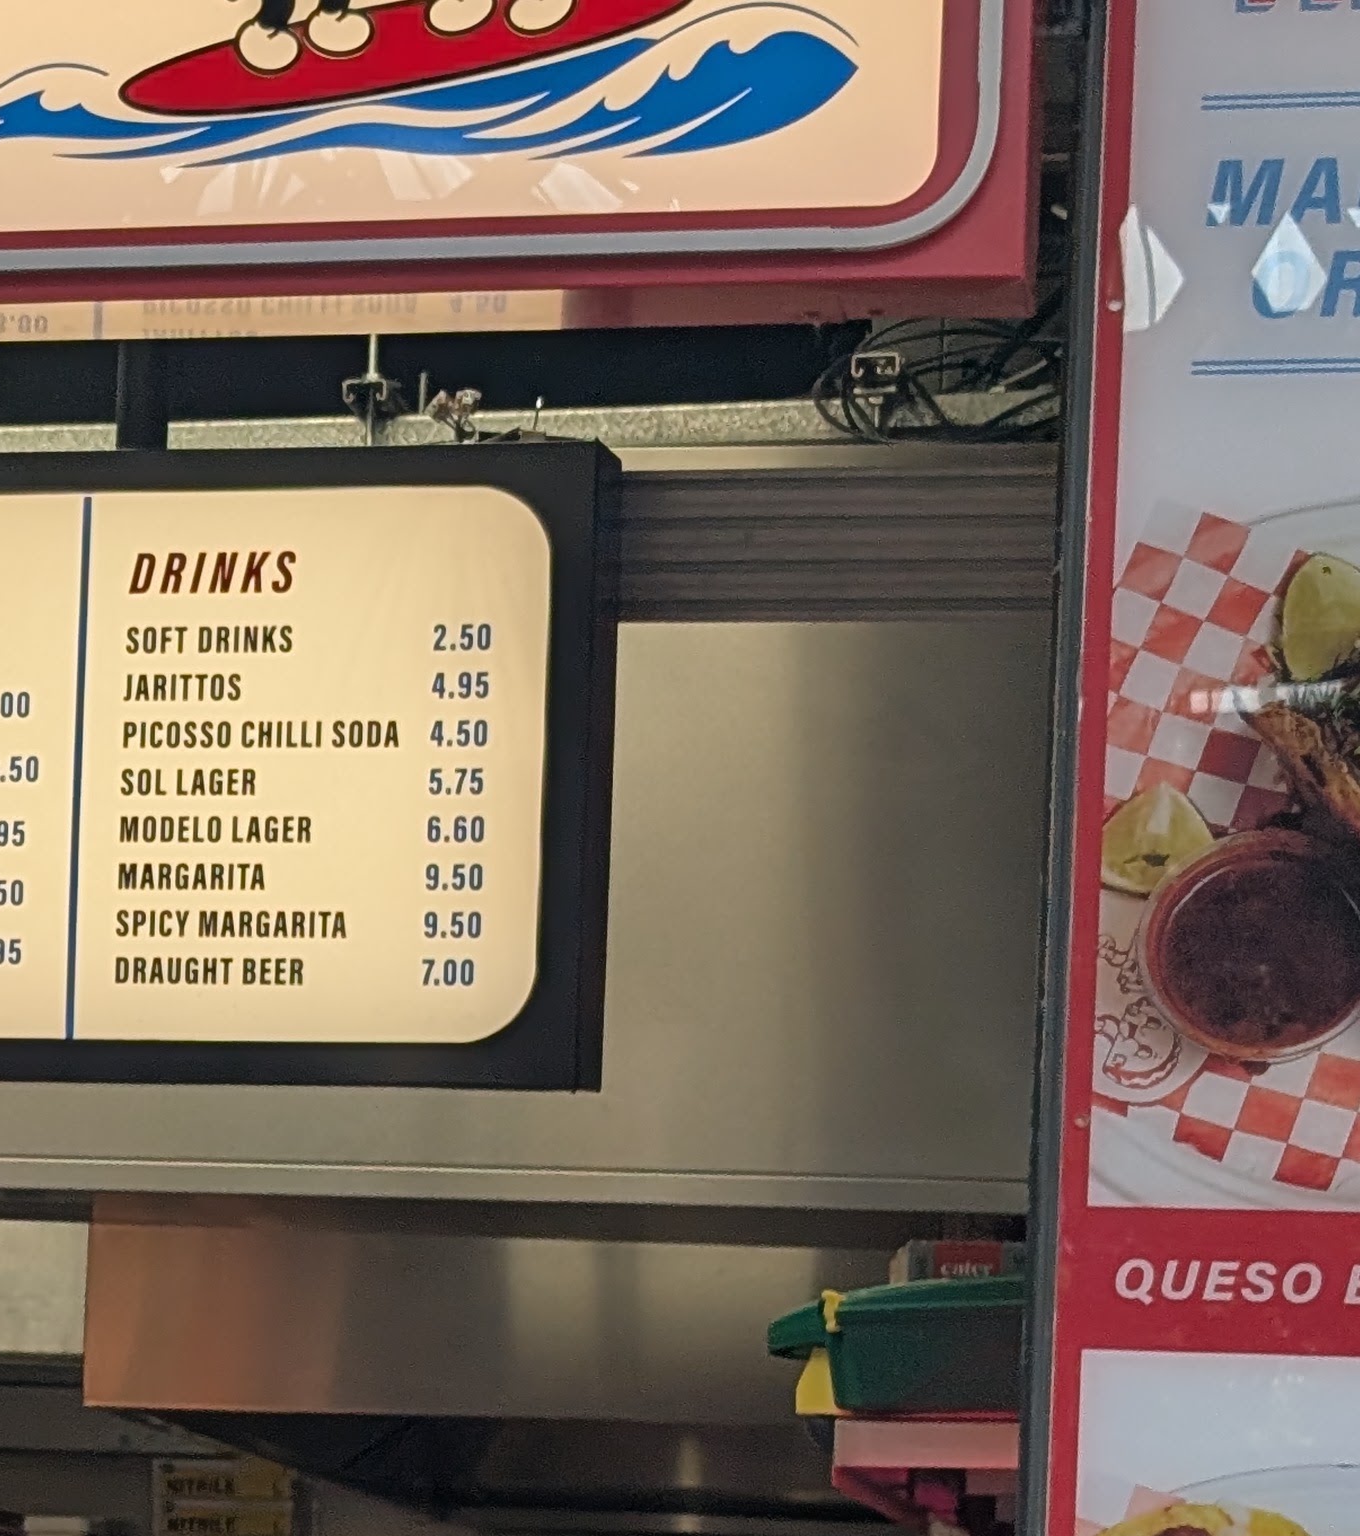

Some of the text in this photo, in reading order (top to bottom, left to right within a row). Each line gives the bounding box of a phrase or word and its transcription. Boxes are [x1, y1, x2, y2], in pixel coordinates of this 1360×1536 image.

[1206, 156, 1360, 228] MA
[128, 550, 297, 595] DRINKS
[125, 623, 492, 655] SOFT DRINKS 2.50
[123, 671, 489, 702] JARITTOS 4.95
[122, 719, 488, 749] PICOSSO CHILLI SODA 4.50
[120, 767, 484, 796] SOL LAGER 5.75
[119, 815, 485, 844] MODELO LAGER 6.60
[118, 862, 483, 891] MARGARITA 9.50
[115, 909, 482, 939] SPICY MARGARITA 9.50
[114, 956, 475, 987] DRAUGHT BEER 7.00
[1114, 1257, 1323, 1306] QUESO
